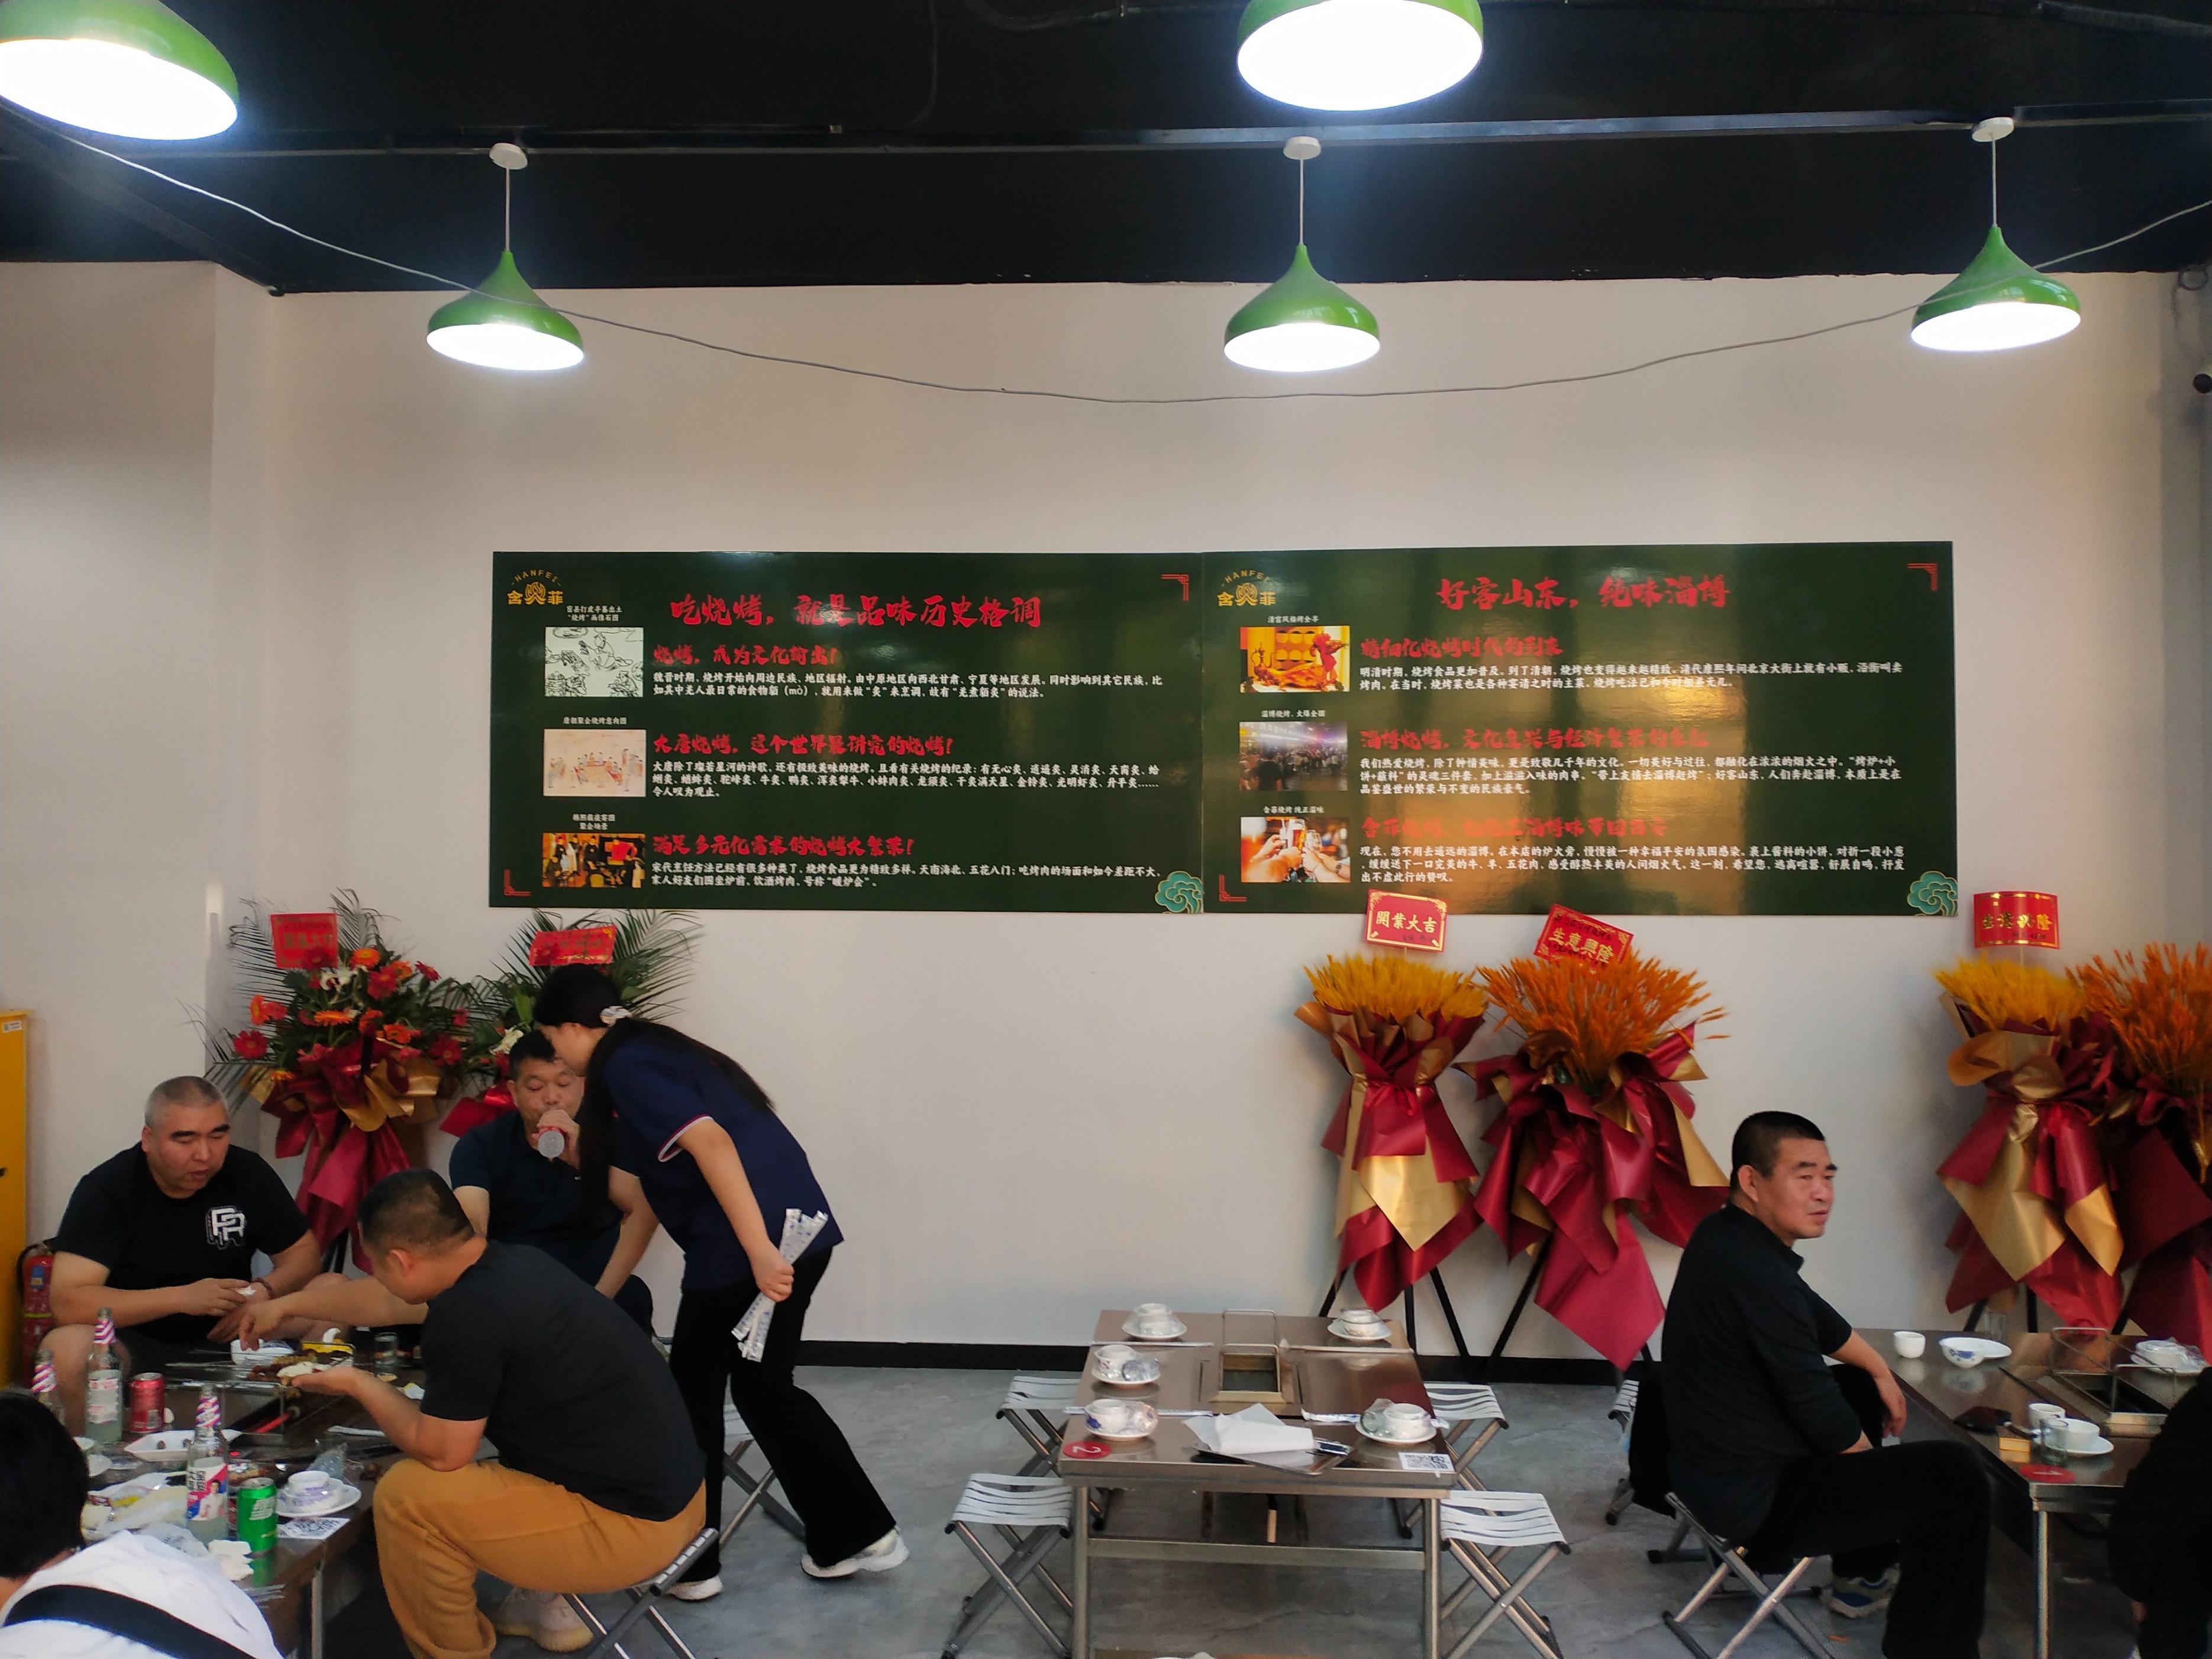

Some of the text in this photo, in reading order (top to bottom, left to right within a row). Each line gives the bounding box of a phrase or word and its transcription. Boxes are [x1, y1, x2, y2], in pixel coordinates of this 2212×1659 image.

[514, 569, 558, 583] HANFEI
[1225, 570, 1270, 583] HANFEI
[1375, 911, 1438, 933] 開業大吉
